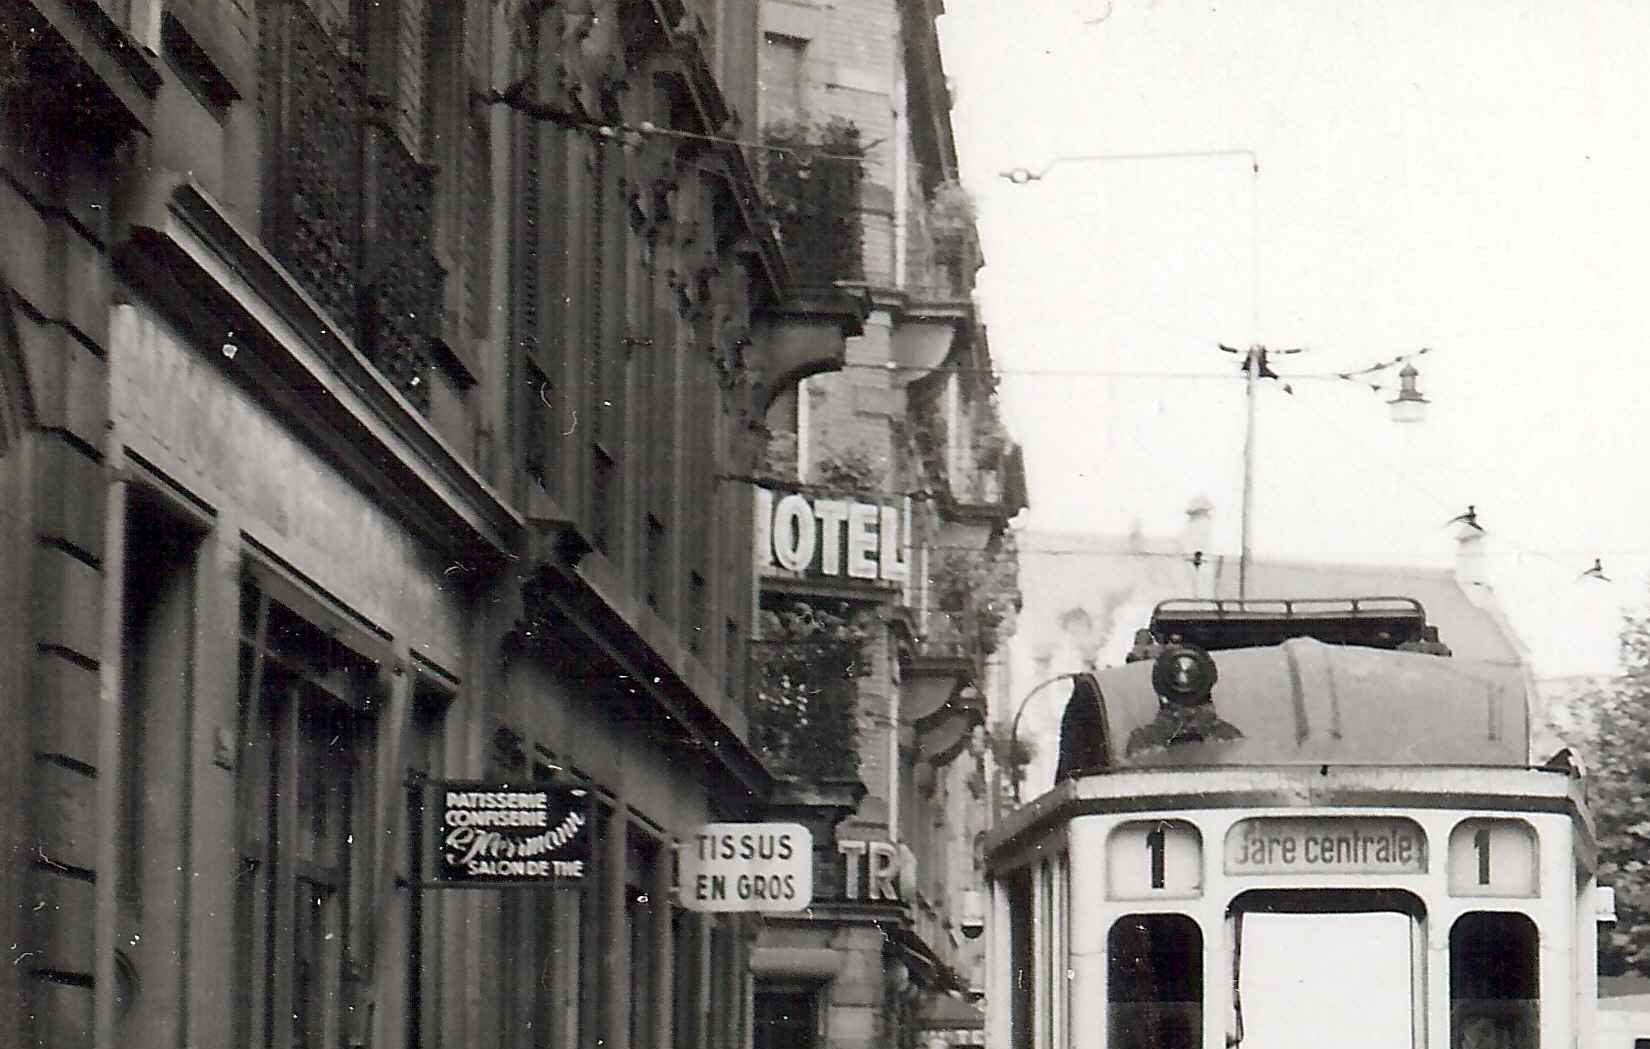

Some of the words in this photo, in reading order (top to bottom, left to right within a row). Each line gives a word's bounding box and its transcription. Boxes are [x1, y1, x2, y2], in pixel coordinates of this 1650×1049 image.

[446, 791, 548, 809] PATISSERIE
[445, 809, 548, 827] CONFISERIE
[698, 834, 793, 861] TISSUS
[1145, 829, 1166, 890] 1
[1304, 829, 1414, 865] centrale
[1474, 829, 1491, 886] 1
[467, 860, 525, 876] SALON
[526, 860, 550, 876] DE
[699, 875, 726, 899] EN
[737, 874, 796, 900] GROS
